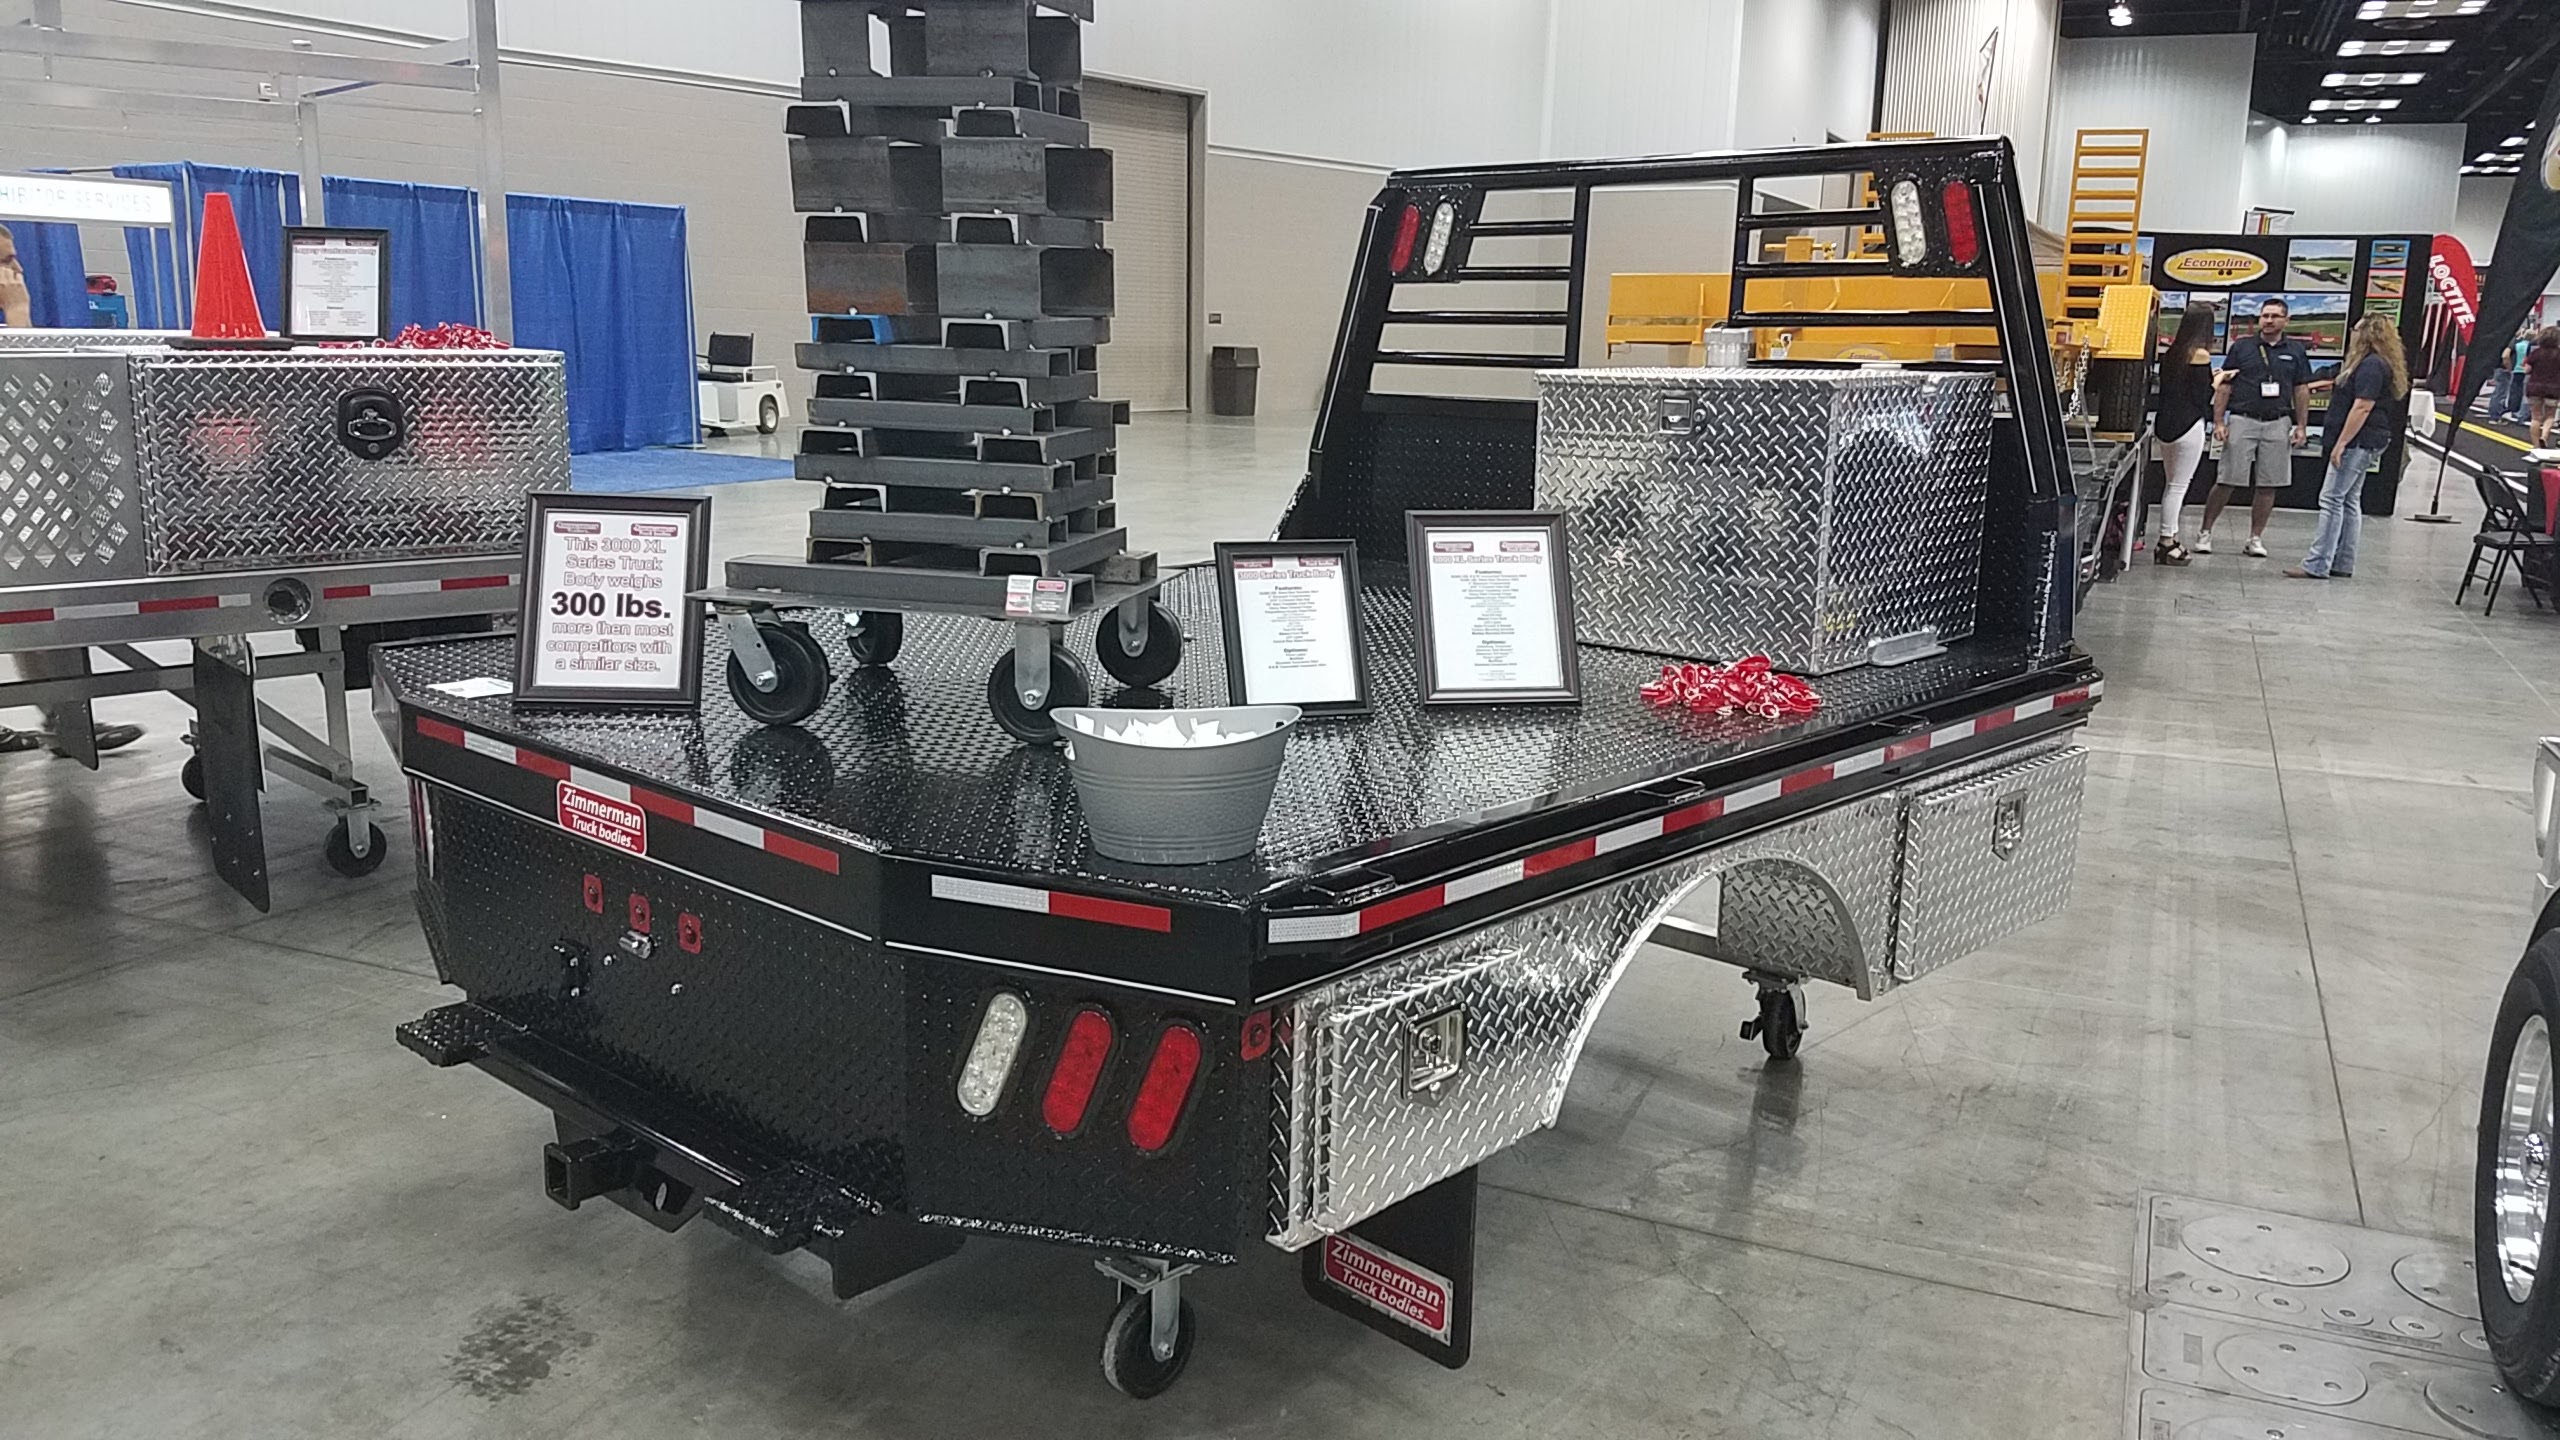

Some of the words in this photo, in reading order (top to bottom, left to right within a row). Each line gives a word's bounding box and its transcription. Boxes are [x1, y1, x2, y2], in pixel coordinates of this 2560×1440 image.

[2183, 257, 2252, 268] Econoline
[2429, 254, 2476, 325] LOCTITE
[564, 536, 598, 552] This
[601, 537, 641, 553] 3000
[644, 538, 667, 554] XL
[565, 553, 616, 569] Series
[618, 555, 663, 571] Truck
[1466, 555, 1494, 564] Series
[1494, 554, 1519, 564] Truck
[1519, 554, 1543, 565] Body
[563, 571, 605, 590] Body
[606, 573, 663, 592] weighs
[1259, 570, 1287, 580] Series
[1287, 569, 1312, 579] Truck
[1312, 568, 1335, 579] Body
[550, 591, 606, 617] 300
[615, 592, 671, 619] lbs.
[551, 622, 593, 635] more
[596, 620, 631, 635] then
[634, 622, 674, 637] most
[545, 639, 637, 656] competitors
[640, 639, 673, 654] with
[554, 657, 567, 670] a
[569, 656, 622, 671] similar
[624, 657, 661, 672] size.
[561, 786, 641, 830] Zimmerman
[571, 813, 598, 836] Truck
[598, 822, 632, 848] bodies
[1331, 1239, 1440, 1307] Zimmerman
[1342, 1267, 1377, 1297] Truck
[1378, 1286, 1425, 1320] bodies
